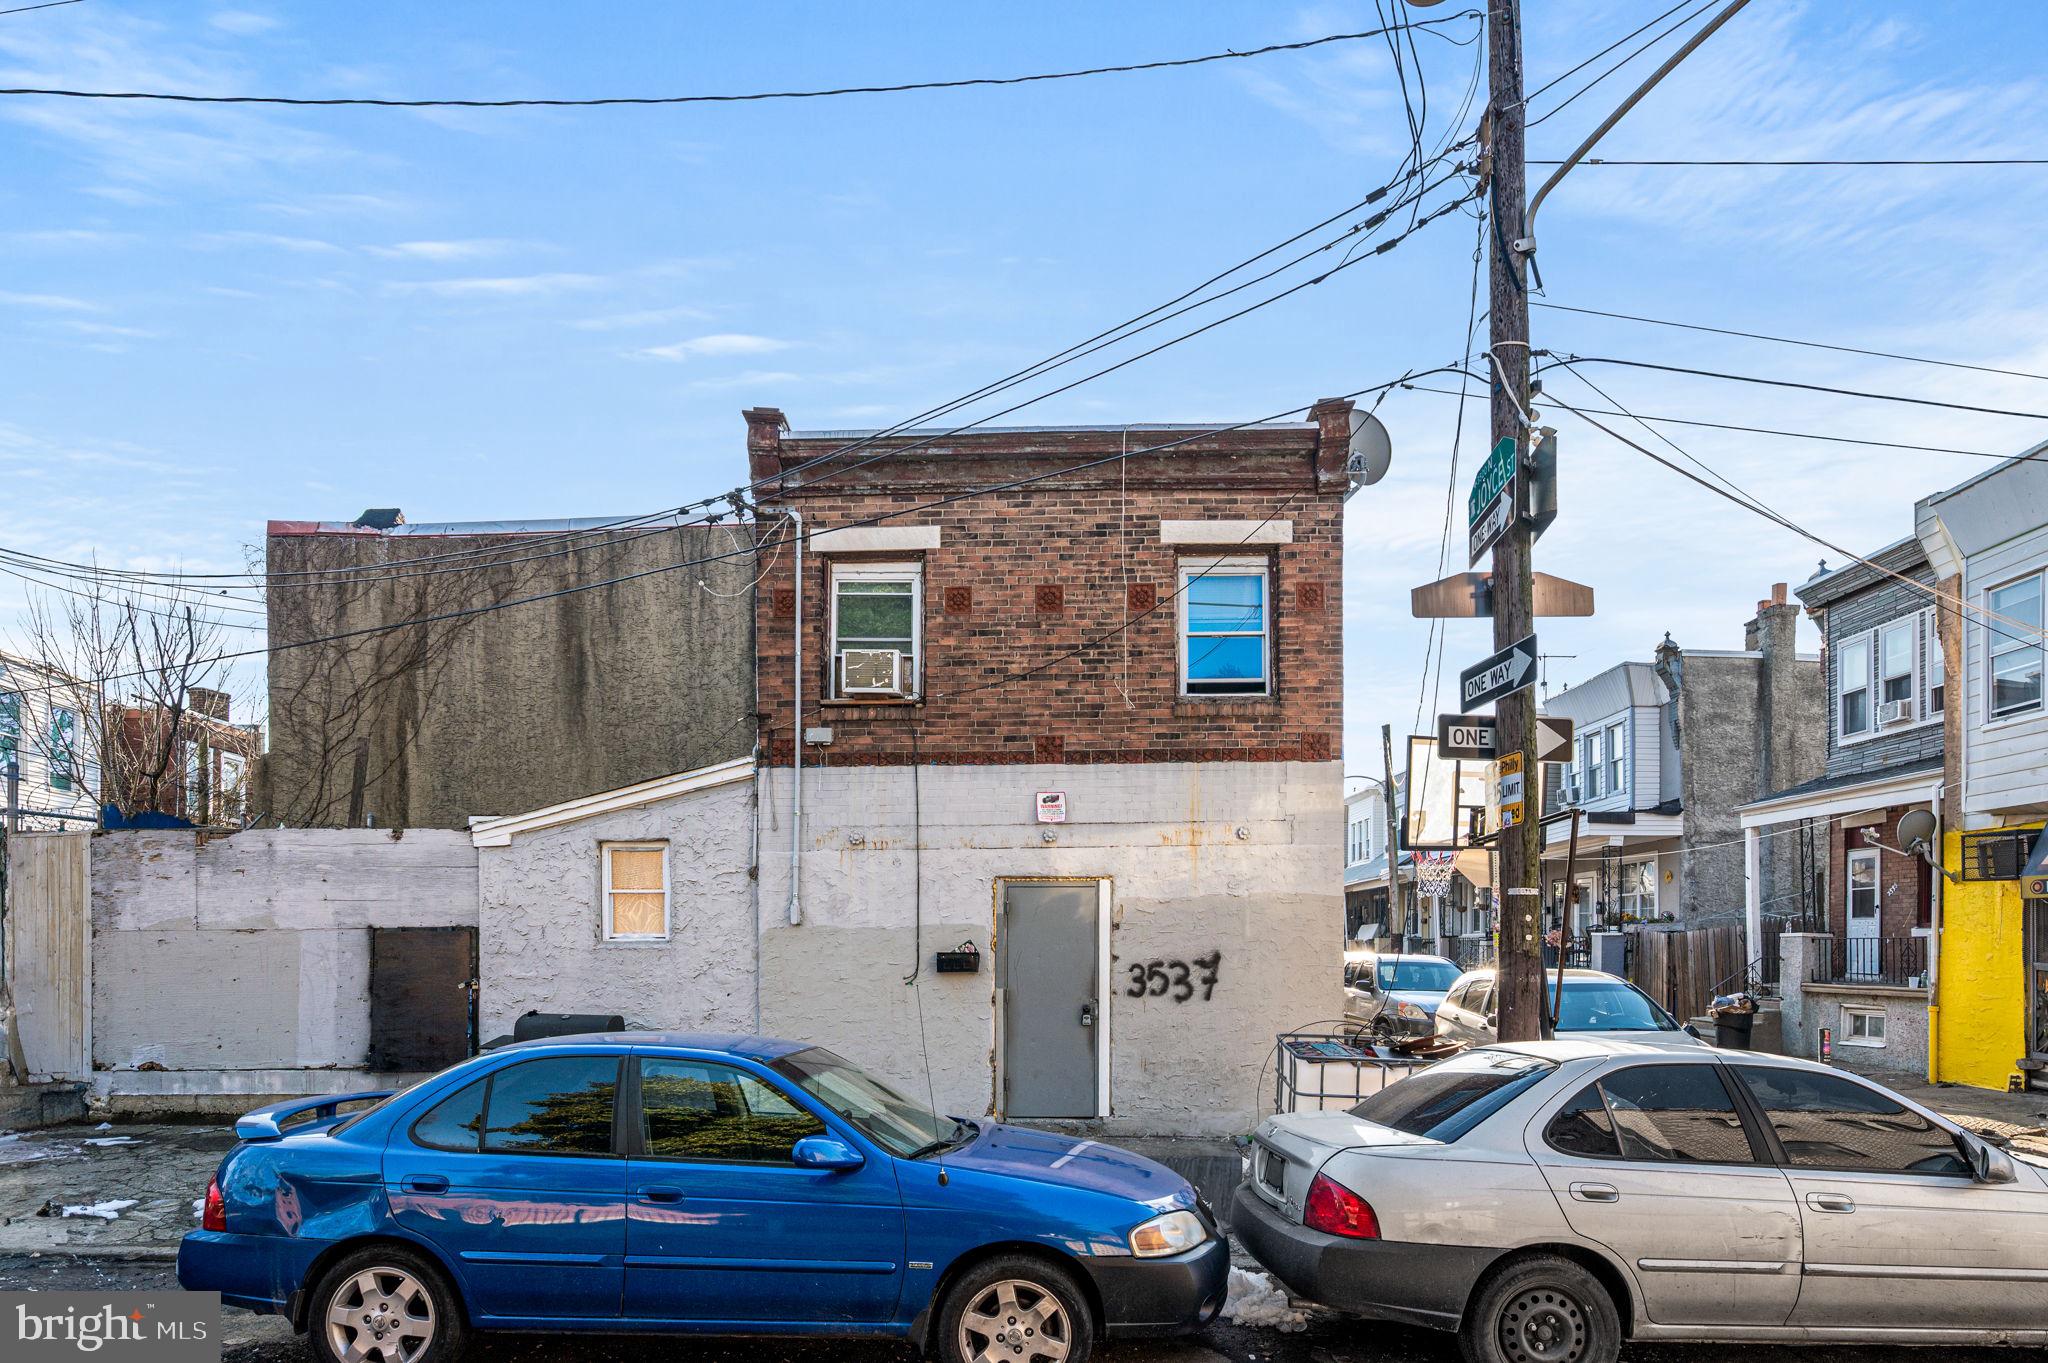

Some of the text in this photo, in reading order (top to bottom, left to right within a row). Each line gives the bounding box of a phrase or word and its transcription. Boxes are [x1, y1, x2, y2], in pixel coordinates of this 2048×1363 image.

[1477, 461, 1506, 515] JOYCE
[1506, 454, 1515, 477] ST
[1473, 523, 1486, 552] ONE
[1466, 660, 1513, 699] ONE WAY
[1453, 729, 1489, 746] ONE
[1502, 781, 1520, 798] LIMIT
[1126, 949, 1222, 1004] 3537
